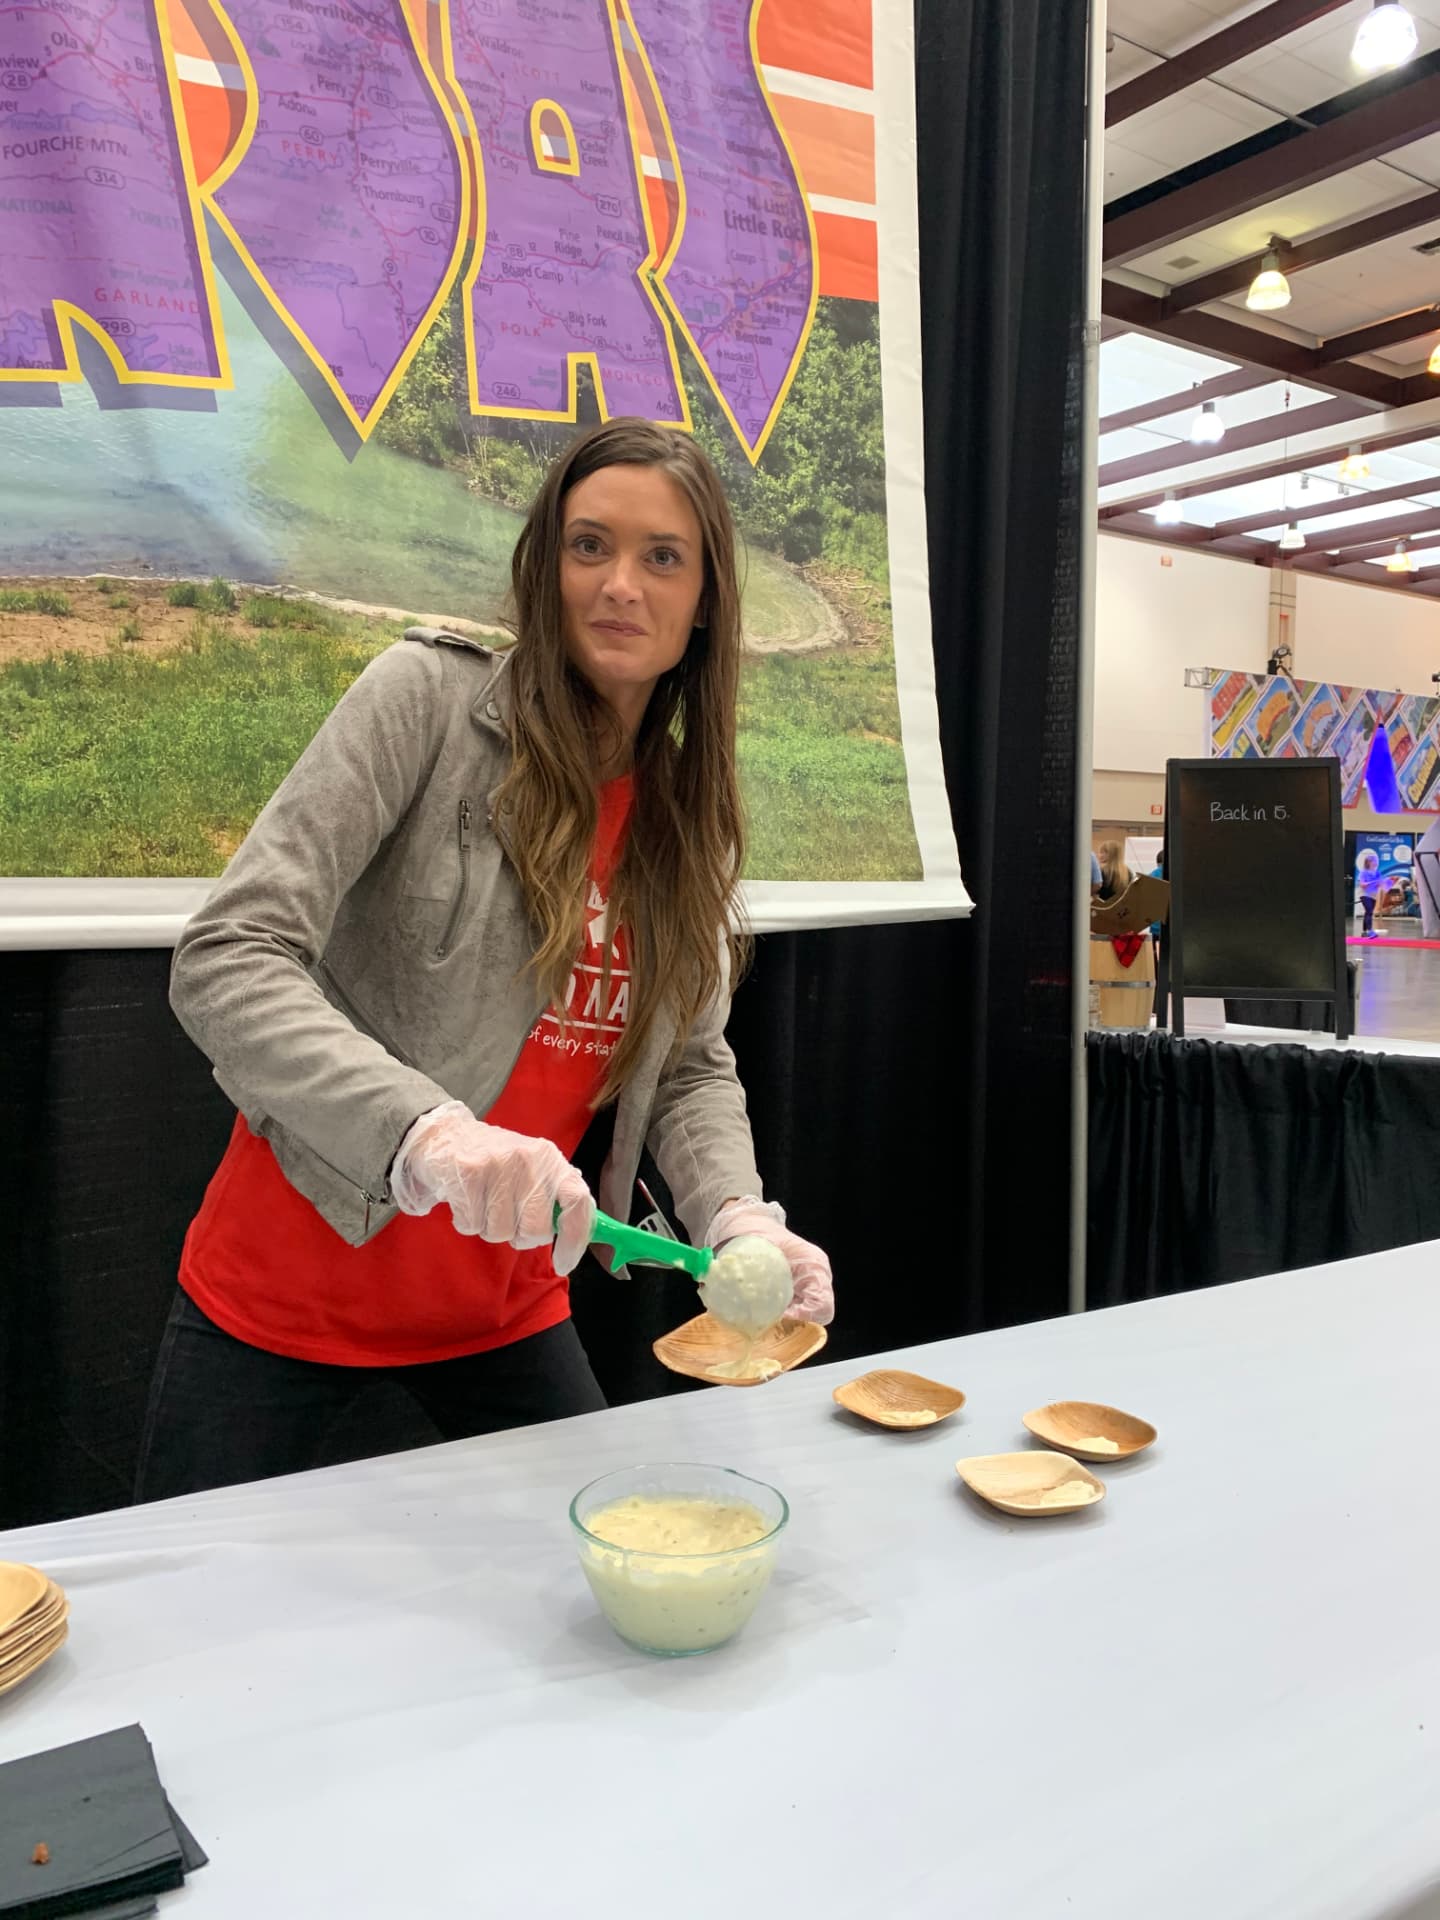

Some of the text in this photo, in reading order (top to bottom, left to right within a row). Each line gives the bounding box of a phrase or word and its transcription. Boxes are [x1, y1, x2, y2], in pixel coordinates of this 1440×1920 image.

[51, 32, 78, 49] Ola
[317, 74, 346, 98] Perry
[3, 136, 86, 160] FOURCHE
[281, 140, 337, 164] PERRY
[363, 185, 425, 208] Thornburg
[724, 210, 769, 235] Little
[502, 263, 564, 284] Board Camp
[501, 321, 541, 338] POLK
[568, 311, 608, 329] Big Fork
[495, 386, 518, 398] 246
[1211, 802, 1250, 822] Back
[1253, 805, 1267, 821] in
[542, 1034, 581, 1057] every
